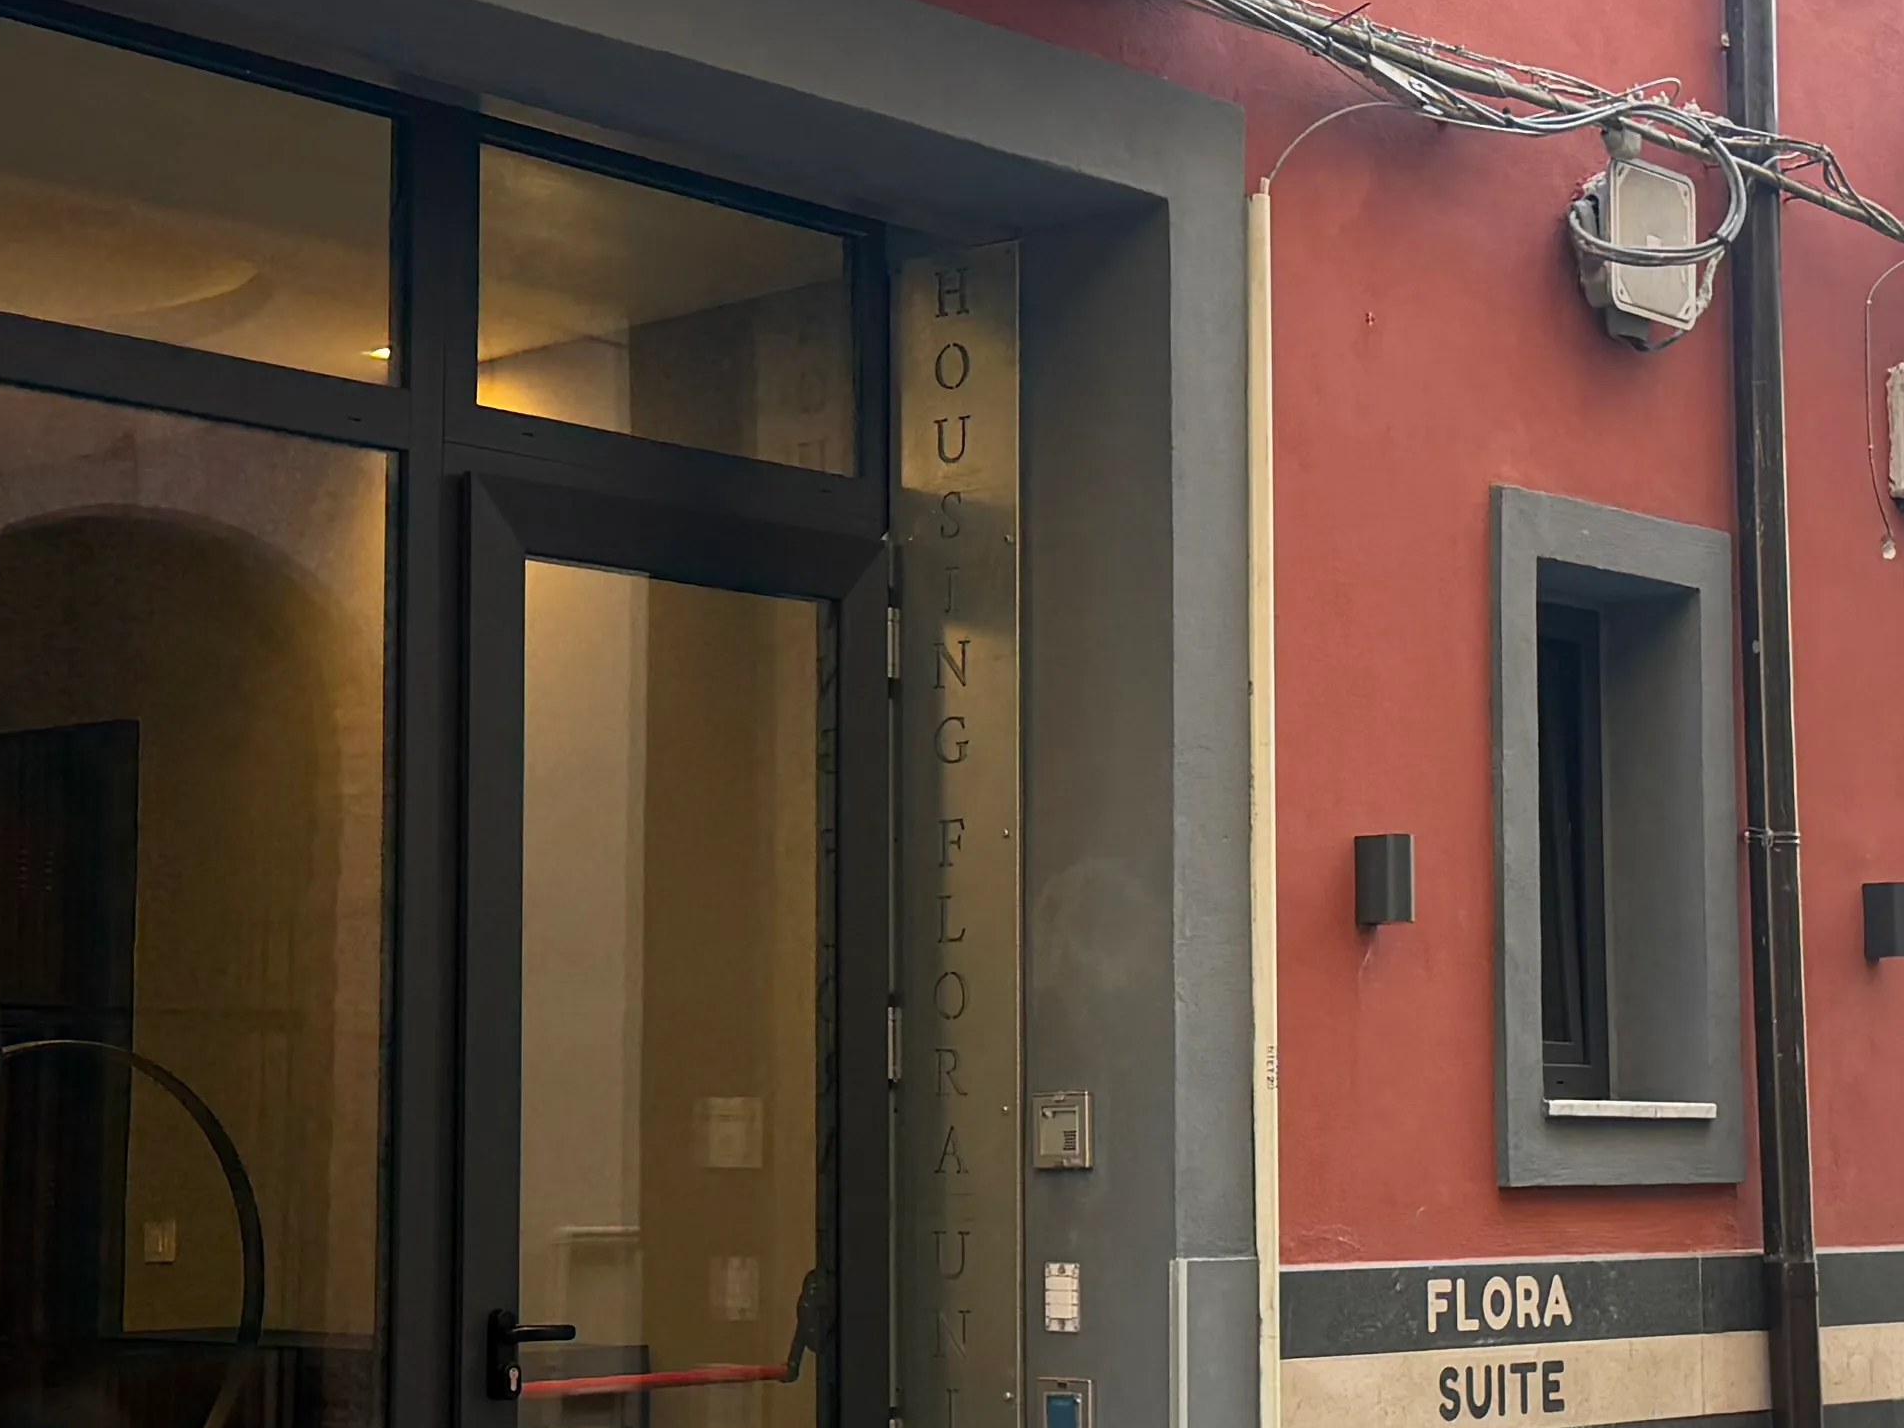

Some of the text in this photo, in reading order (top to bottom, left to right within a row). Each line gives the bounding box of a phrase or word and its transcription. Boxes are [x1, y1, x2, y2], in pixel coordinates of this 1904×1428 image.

[933, 267, 972, 765] HOUSING
[931, 818, 970, 1175] FLORA
[1427, 1274, 1572, 1333] FLORA
[1439, 1360, 1565, 1422] SUITE
